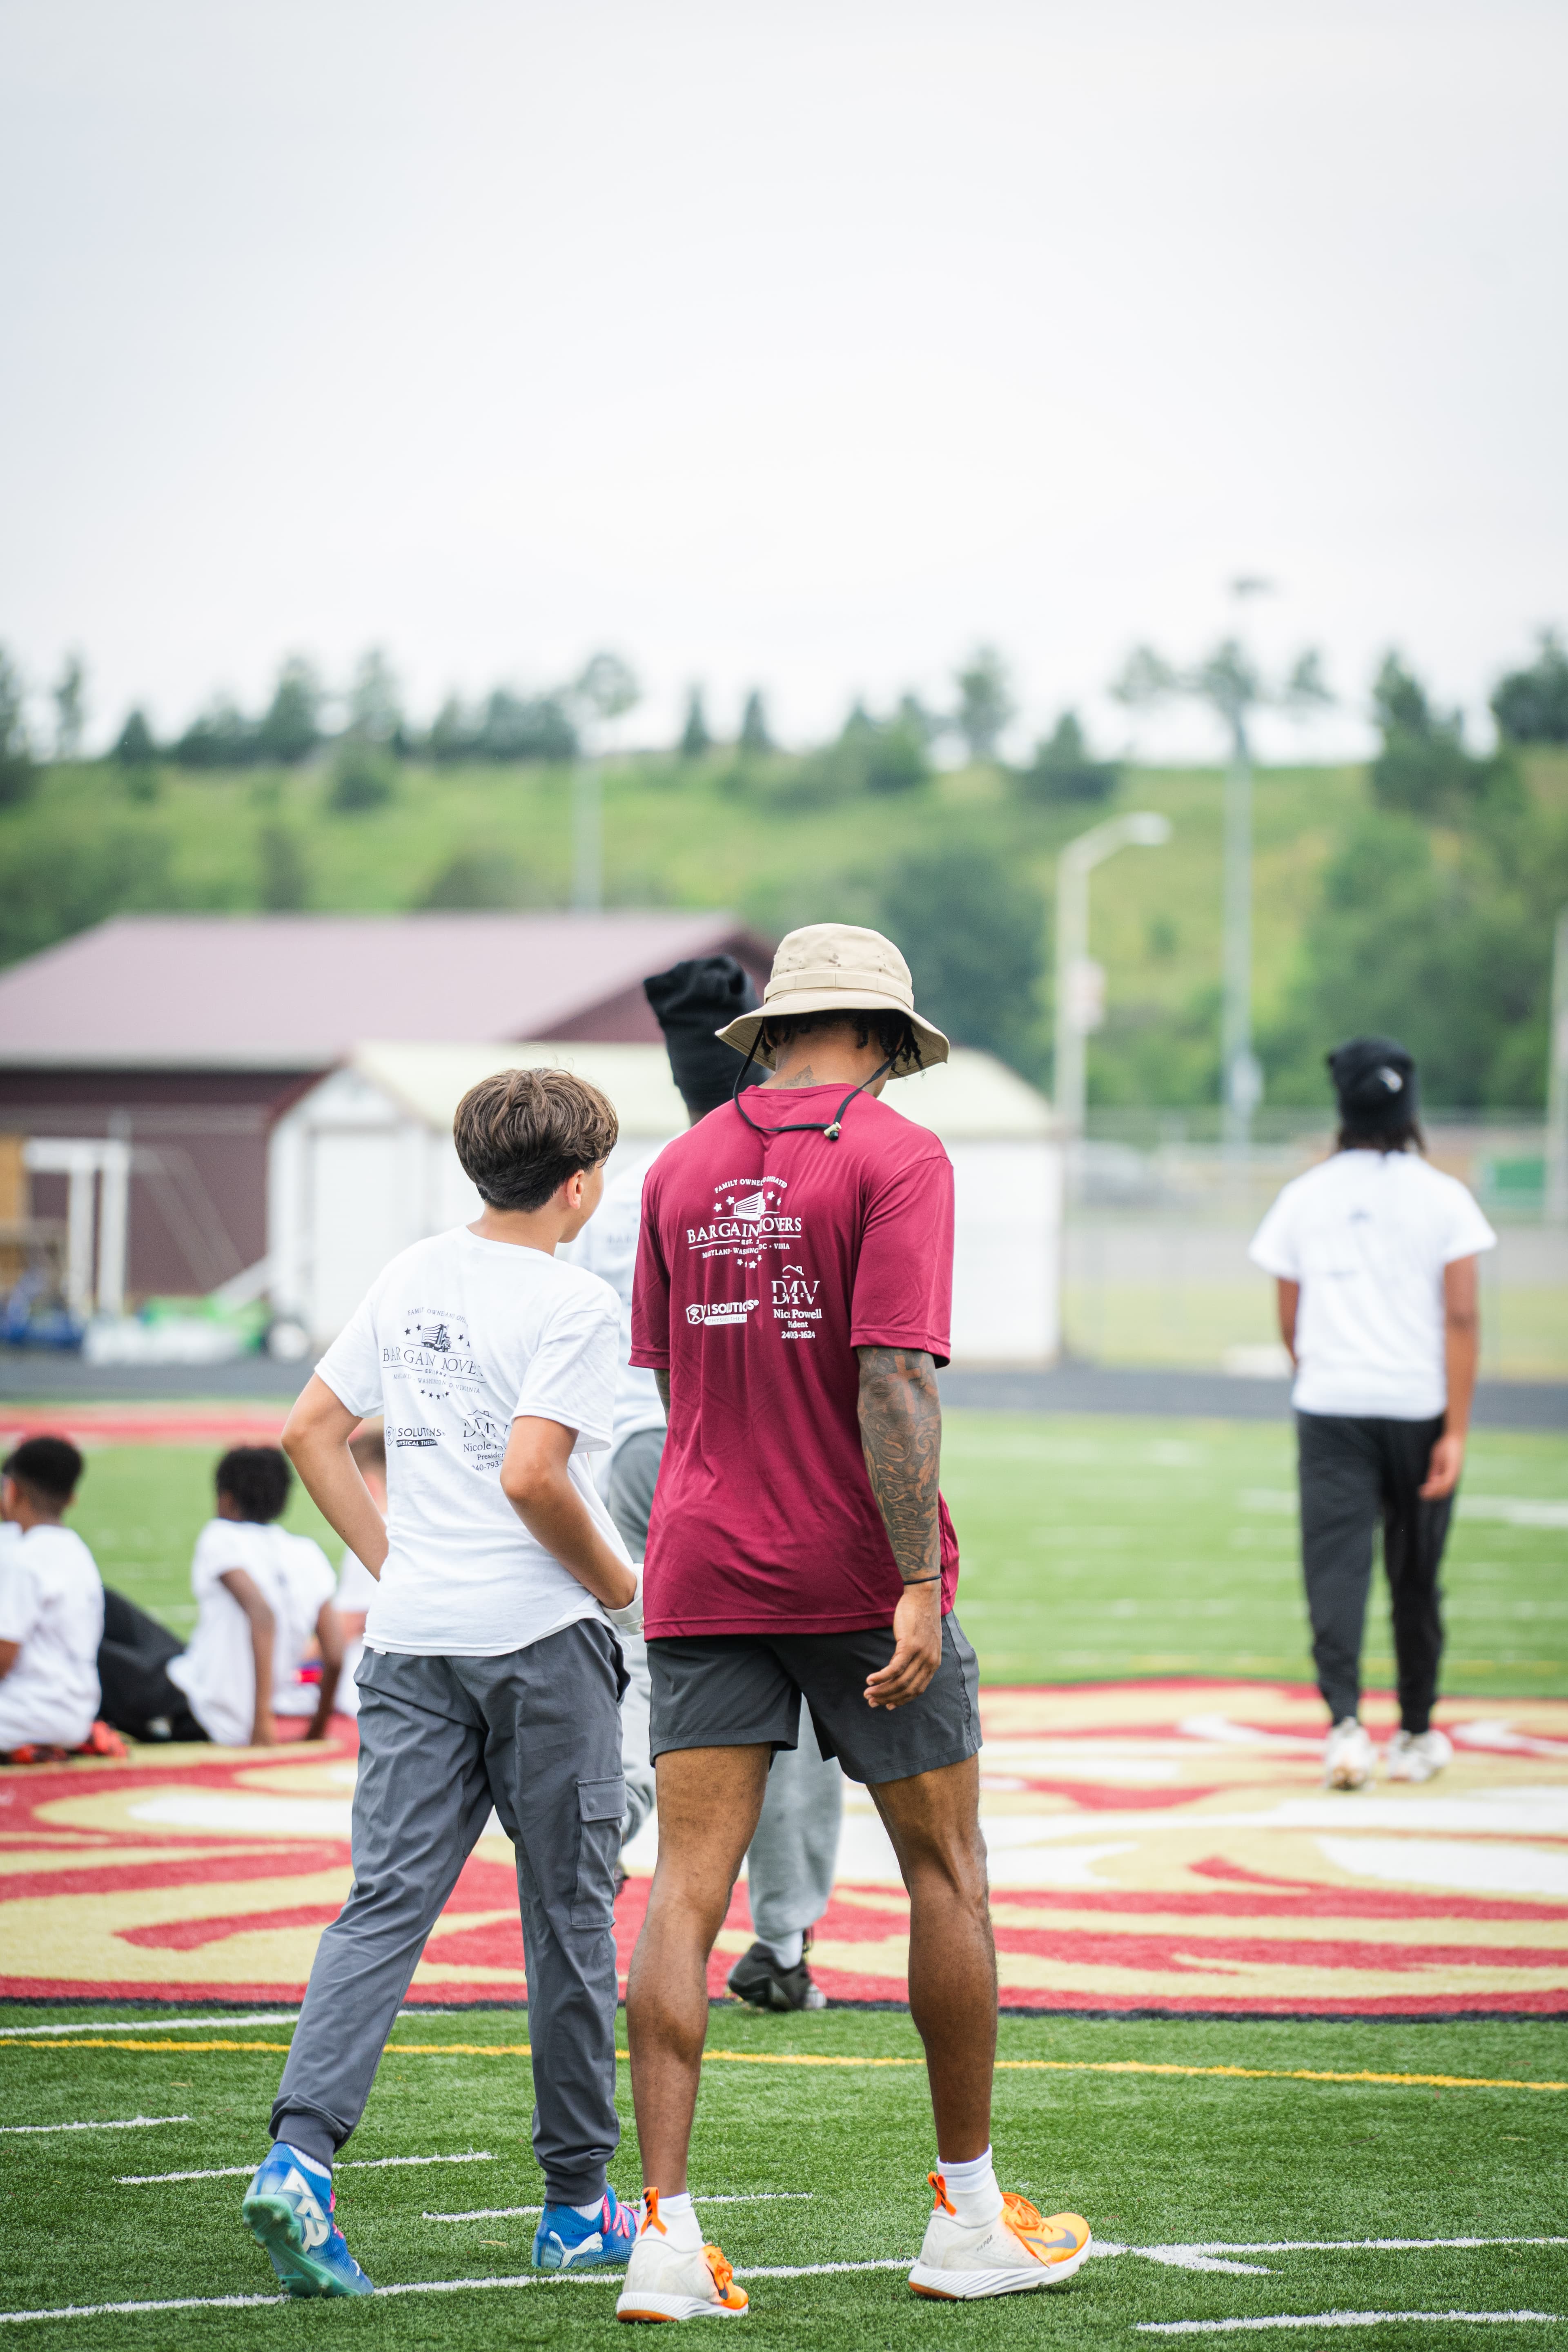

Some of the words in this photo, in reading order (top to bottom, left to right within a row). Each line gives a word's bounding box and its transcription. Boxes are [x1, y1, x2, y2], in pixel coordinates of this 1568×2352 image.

[714, 1179, 738, 1194] FAMILY
[687, 1222, 760, 1243] BARGAIN
[791, 1308, 822, 1319] Powell
[463, 1441, 491, 1452] Nicole
